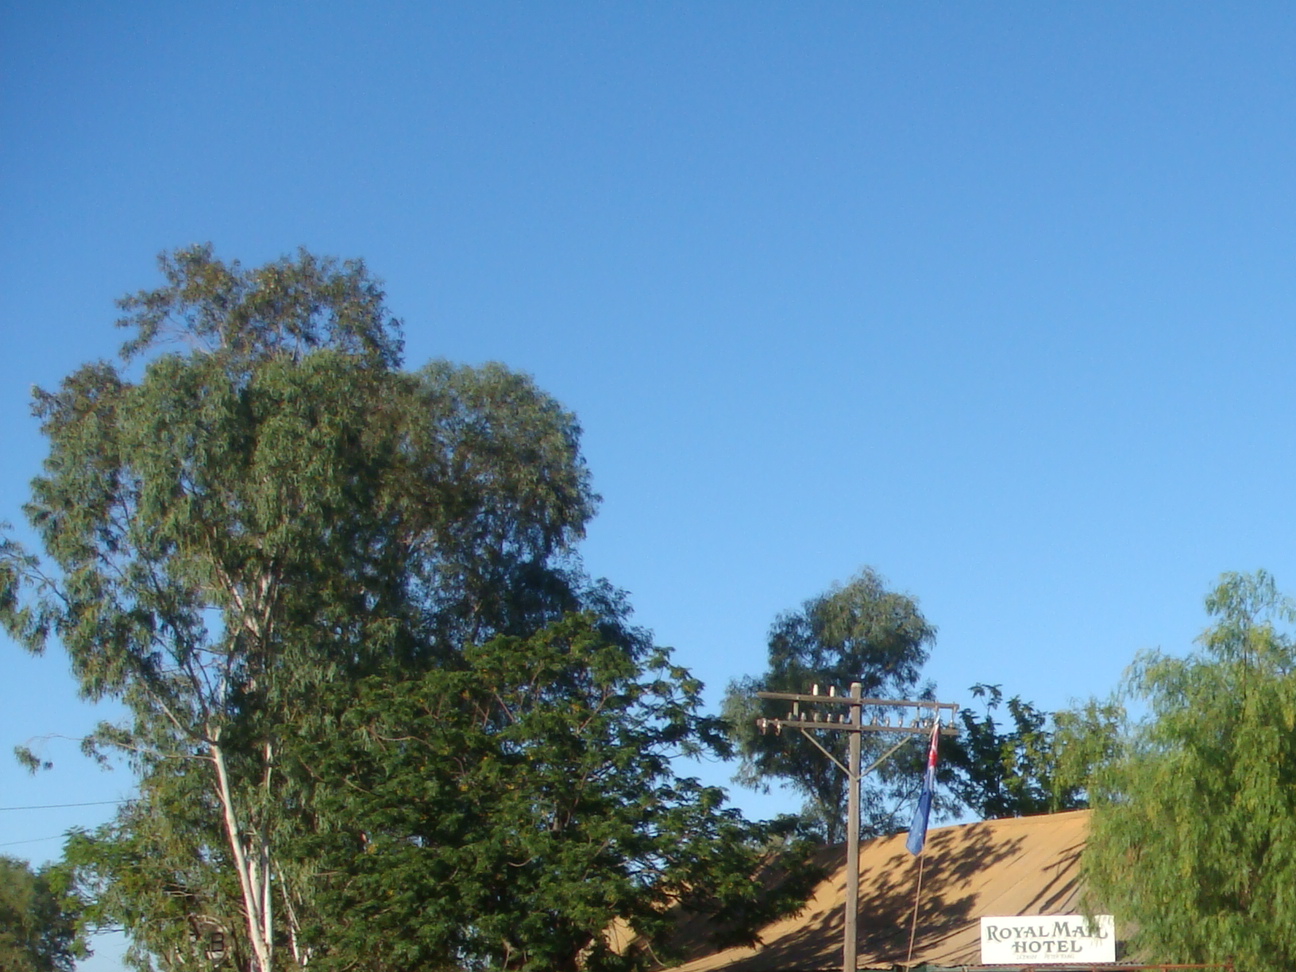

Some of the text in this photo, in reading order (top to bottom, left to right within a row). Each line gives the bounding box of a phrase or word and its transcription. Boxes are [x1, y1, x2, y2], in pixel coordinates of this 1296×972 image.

[986, 921, 1109, 943] ROYAL MAIL
[1012, 940, 1083, 953] HOTEL
